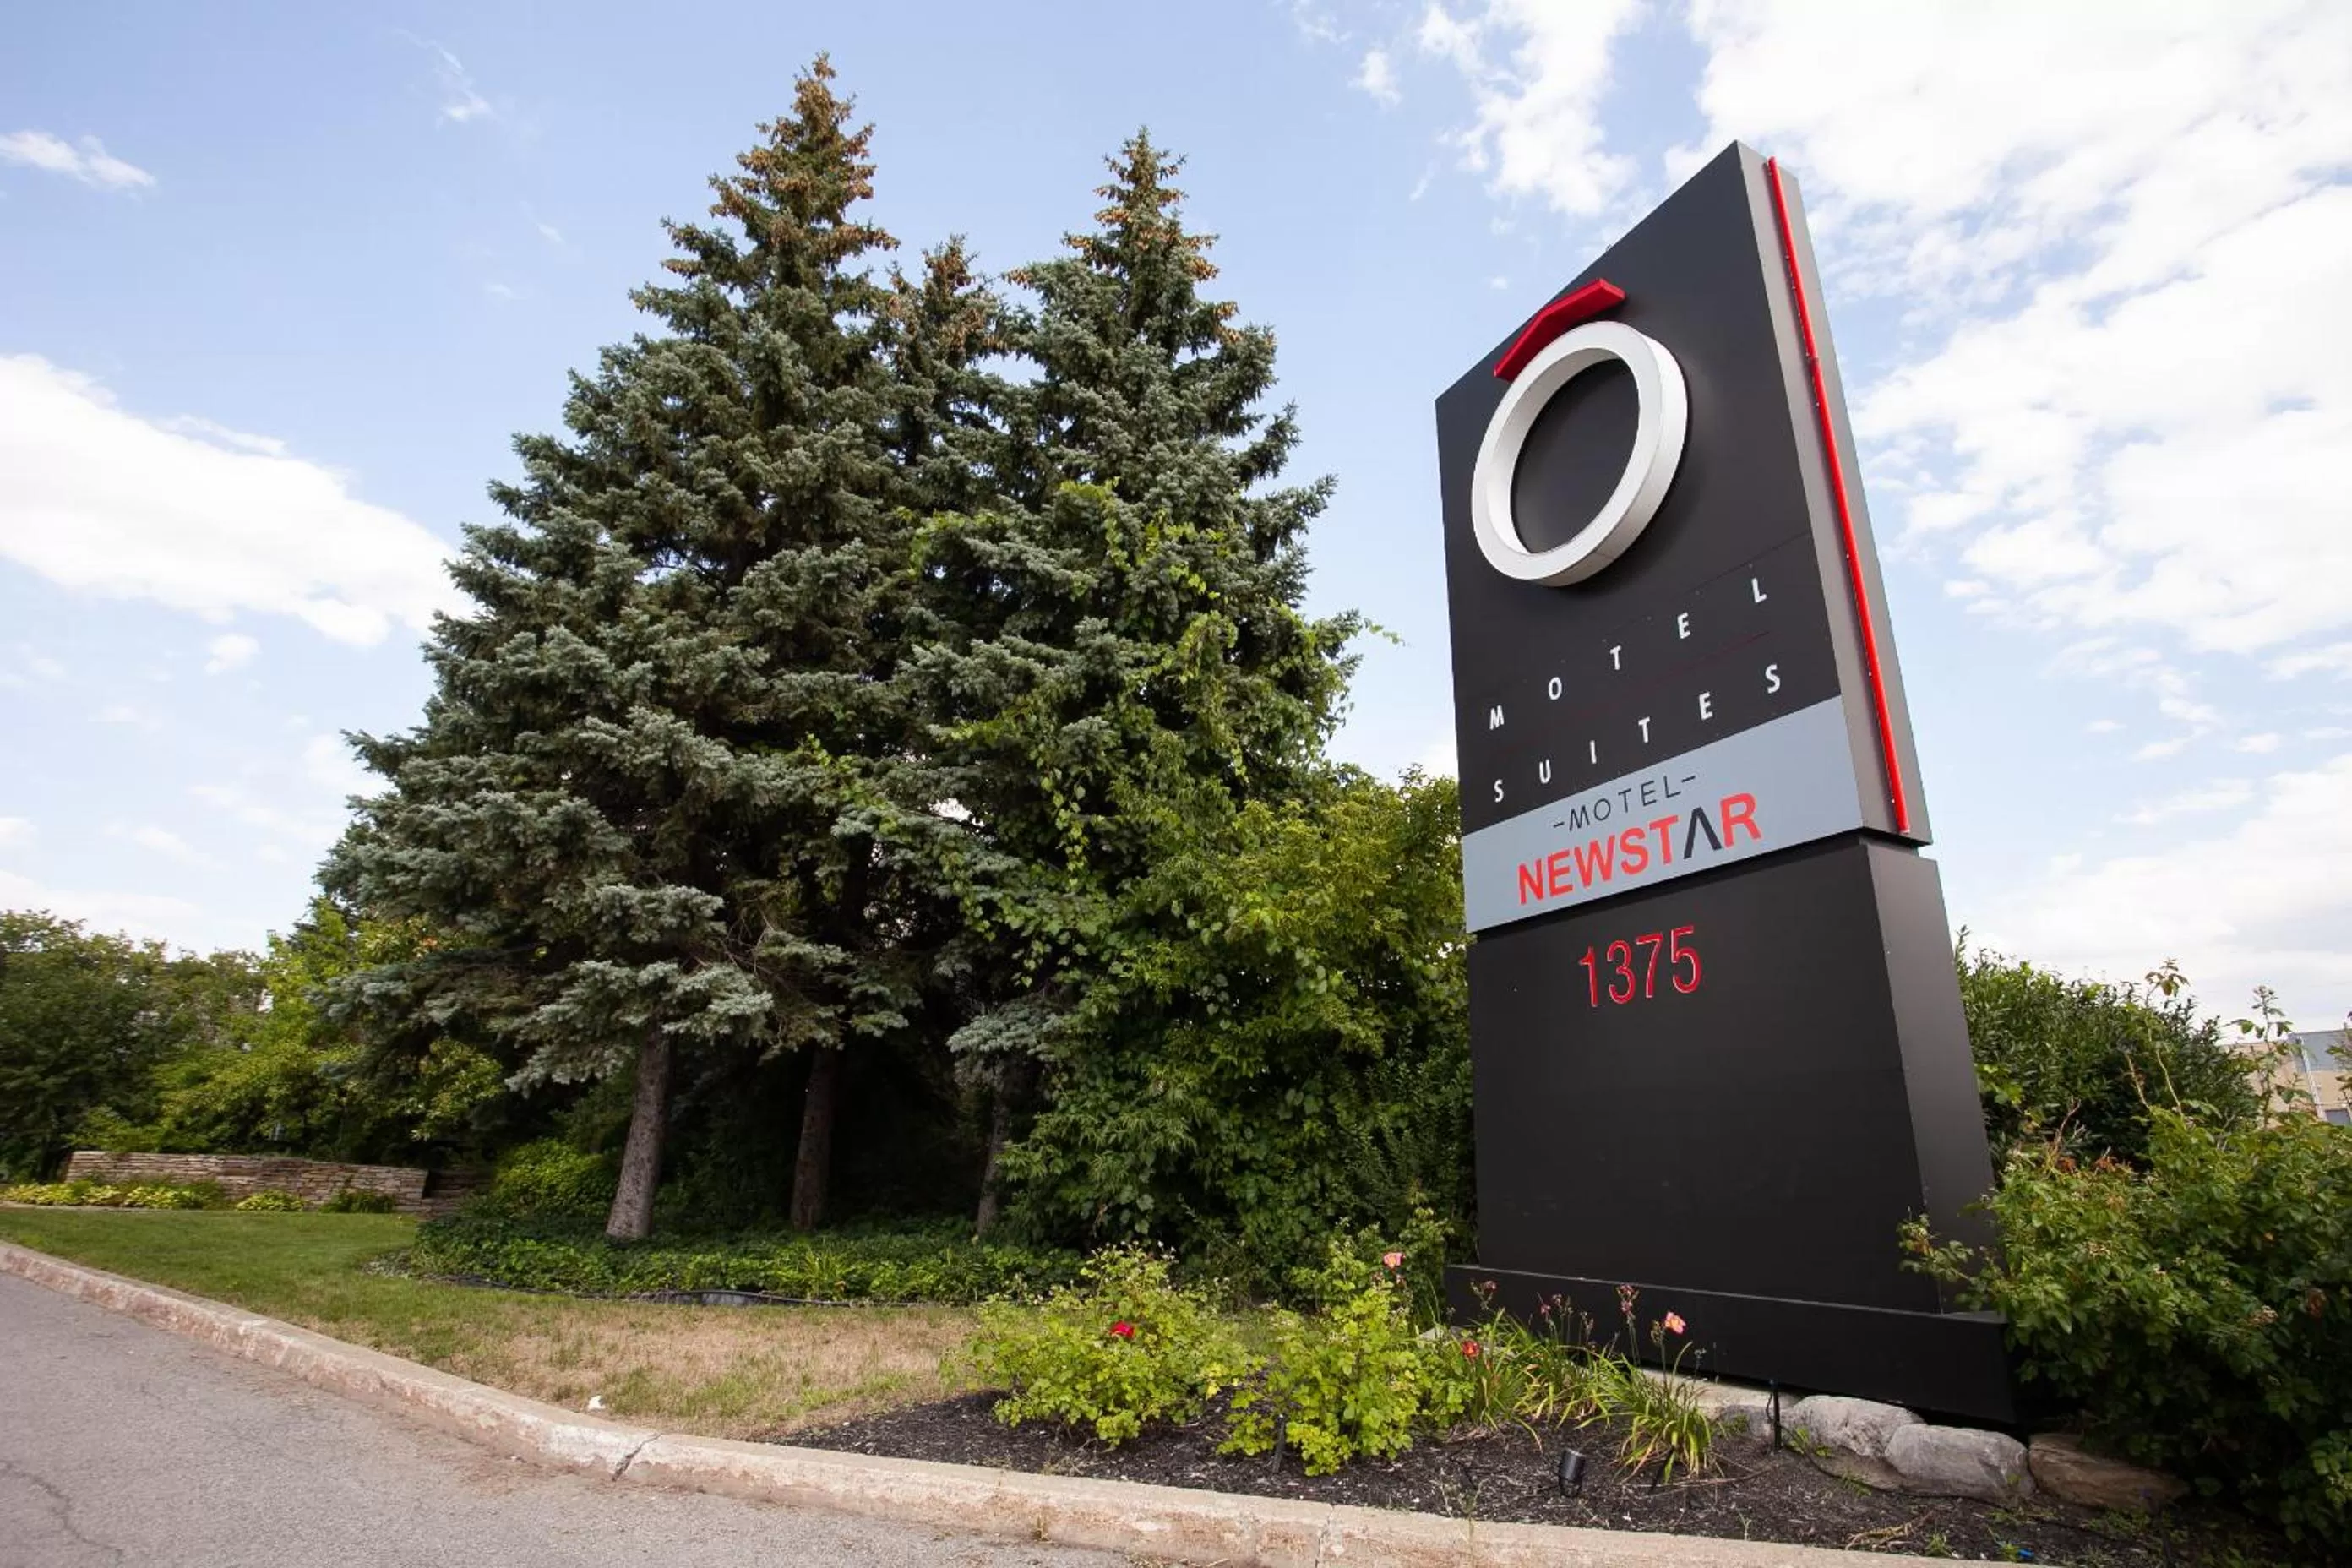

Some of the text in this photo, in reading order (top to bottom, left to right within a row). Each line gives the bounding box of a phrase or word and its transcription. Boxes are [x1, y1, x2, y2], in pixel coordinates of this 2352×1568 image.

[1489, 578, 1767, 730] MOTEL
[1494, 664, 1780, 803] SUITES
[1517, 792, 1761, 904] NEWSTAR
[1578, 925, 1702, 1007] 1375
